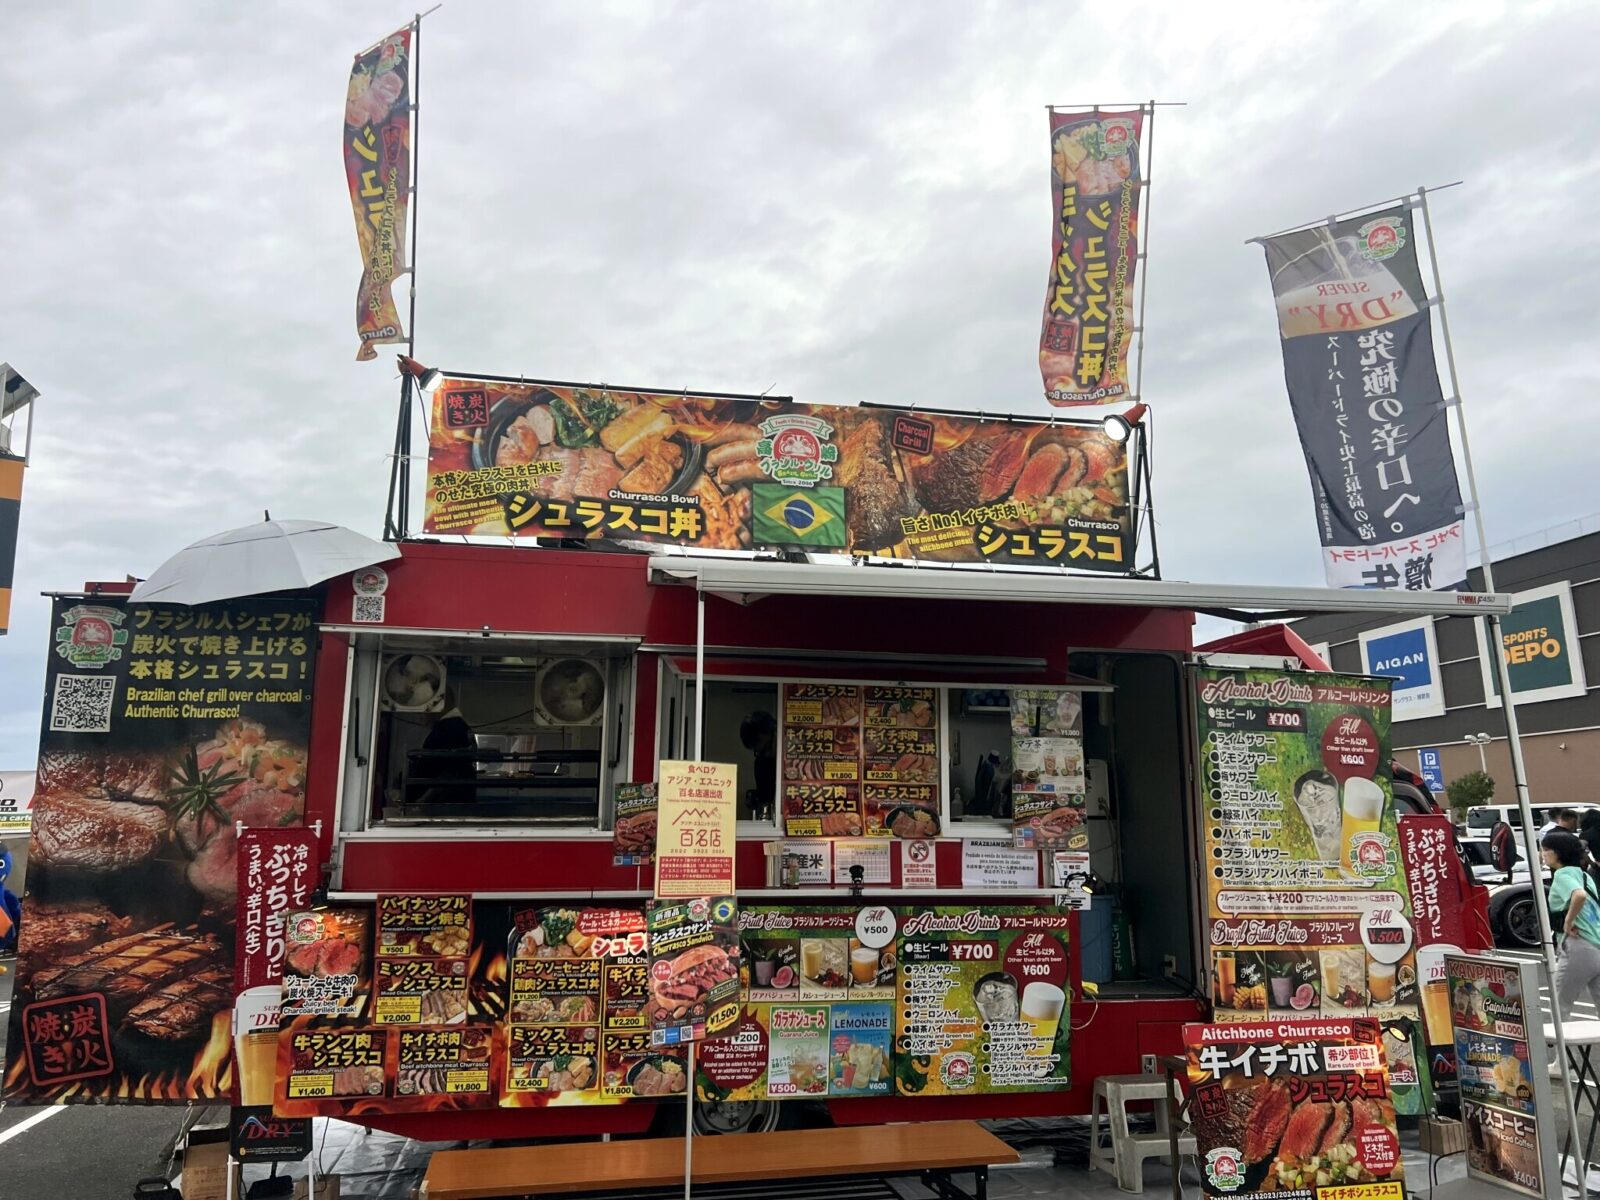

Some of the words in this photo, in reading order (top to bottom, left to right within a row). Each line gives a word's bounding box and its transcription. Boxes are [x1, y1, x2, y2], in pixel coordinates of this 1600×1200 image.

[447, 394, 466, 424] 焼き
[467, 395, 487, 424] 炭火
[898, 421, 931, 438] Charcoal
[902, 436, 922, 449] Grill
[432, 459, 563, 490] 本格シュラスコを白米に
[434, 478, 541, 505] のせた究極の肉丼！
[608, 490, 668, 503] Churrasco
[670, 493, 699, 505] Bowl
[508, 494, 702, 539] シュラスコ丼
[1068, 518, 1120, 531] Churrasco
[978, 525, 1123, 562] シュラスコ
[134, 609, 312, 631] ブラジル人シェフが
[1502, 626, 1548, 646] SPORTS
[131, 634, 308, 656] 炭火で焼き上げる
[1375, 651, 1425, 672] AIGAN
[128, 659, 308, 680] 本格シュラスコ！
[127, 686, 176, 702] Brazilian
[178, 686, 206, 702] chef
[206, 688, 229, 704] grill
[229, 690, 254, 702] over
[256, 689, 303, 703] charcoal
[806, 685, 857, 697] シュラスコ
[873, 687, 934, 700] シュラスコ丼
[1203, 676, 1268, 703] Alcohol
[1267, 677, 1313, 703] Drink
[1317, 688, 1390, 704] アルコールドリンク
[125, 703, 179, 719] Authentic
[181, 704, 241, 719] Churrasco!
[1215, 708, 1256, 720] 生ビール
[1268, 712, 1300, 726] ¥700
[1339, 717, 1361, 735] All
[786, 728, 833, 741] 牛イチボ肉
[865, 728, 919, 742] 牛イチボ肉
[1217, 733, 1275, 746] ライムサワー
[1333, 736, 1368, 746] 生ビール以外
[786, 742, 833, 754] シュラスコ
[1220, 751, 1277, 764] レモンサワー
[1340, 754, 1365, 765] ¥600
[687, 764, 717, 775] 食べログ
[667, 775, 732, 787] アジア・エスニック
[786, 785, 847, 799] 牛ランプ肉
[865, 786, 931, 799] シュラスコ丼
[1223, 791, 1279, 802] ウーロンハイ
[802, 799, 857, 813] シュラスコ
[1222, 809, 1259, 821] 緑茶ハイ
[679, 827, 722, 847] 百名店
[1223, 829, 1271, 840] ハイボール
[1223, 848, 1289, 859] ブラジルサワー
[1434, 828, 1448, 879] 冷やして
[292, 844, 310, 907] 冷やして
[1224, 866, 1324, 880] ブラジリアンハイボール
[1418, 828, 1442, 939] ぶっちぎりに
[381, 896, 468, 910] パイナップル
[264, 843, 293, 979] ぶっちぎりに
[865, 910, 886, 923] All
[1369, 909, 1392, 925] All
[381, 912, 467, 926] シナモン焼き
[738, 911, 764, 929] Fruit
[764, 911, 793, 929] Juice
[903, 911, 961, 936] Alcohol
[960, 910, 1000, 934] Drink
[1004, 917, 1068, 928] アルコールドリンク
[652, 919, 714, 945] シュラスコサンド
[863, 925, 888, 934] ¥500
[1211, 919, 1246, 948] Brazil
[1246, 919, 1275, 945] Fruit
[1275, 919, 1309, 944] Juice
[1309, 921, 1355, 933] ブラジルフルーツ
[593, 934, 648, 957] シュラ
[652, 937, 687, 957] Churrasco
[687, 934, 715, 948] Sandwich
[1023, 933, 1044, 948] All
[1321, 933, 1345, 944] ジュース
[913, 943, 949, 953] 生ビール
[952, 944, 993, 960] ¥700
[1016, 948, 1056, 956] 生ビール以外
[514, 960, 600, 975] ポークソーセージ丼
[617, 957, 635, 965] BBQ
[379, 961, 435, 976] ミックス
[912, 965, 960, 974] ライムサワー
[1022, 964, 1050, 976] ¥600
[1449, 960, 1507, 986] KANPAI!!
[286, 973, 358, 988] ジューシーな牛肉の
[402, 976, 466, 990] シュラスコ
[912, 980, 960, 989] レモンサワー
[751, 991, 797, 999] グアバジュース
[802, 991, 847, 999] カシュージュース
[912, 995, 944, 1004] 梅サワー
[303, 1000, 324, 1009] Juicy
[325, 999, 338, 1007] beef
[1481, 997, 1521, 1016] Caipirinha
[382, 1014, 411, 1023] ¥2,000
[773, 1010, 826, 1028] ガラナジュース
[912, 1009, 959, 1018] ウーロンハイ
[613, 1017, 640, 1026] ¥2,200
[834, 1017, 888, 1028] LEMONADE
[991, 1022, 1037, 1031] ガラナサワー
[512, 1027, 566, 1042] ミックス
[912, 1025, 943, 1034] 緑茶ハイ
[1201, 1025, 1274, 1041] Aitchbone
[1277, 1023, 1350, 1038] Churrasco
[30, 1013, 66, 1074] 焼き
[69, 1004, 108, 1070] 炭火
[294, 1033, 372, 1051] 牛ランプ肉
[401, 1032, 461, 1047] 牛イチボ肉
[912, 1039, 952, 1049] ハイボール
[522, 1041, 597, 1056] シュラスコ丼
[991, 1043, 1045, 1052] ブラジルサワー
[1327, 1047, 1375, 1061] 希少部位！
[1467, 1042, 1502, 1053] レモネード
[313, 1050, 381, 1067] シュラスコ
[401, 1048, 460, 1062] シュラスコ
[1199, 1040, 1319, 1079] 牛イチボ
[1464, 1051, 1501, 1063] LEMONADE
[991, 1063, 1055, 1073] ブラジルハイボール
[454, 1083, 481, 1091] ¥1,800
[515, 1078, 543, 1087] ¥2,400
[770, 1083, 797, 1093] ¥500
[869, 1082, 887, 1090] ¥600
[1289, 1072, 1387, 1103] シュラスコ
[298, 1087, 326, 1096] ¥1,400
[605, 1086, 631, 1095] ¥1,800
[1464, 1101, 1535, 1137] アイスコーヒー
[1364, 1142, 1391, 1153] ビネガー
[1513, 1137, 1535, 1150] Coffee
[1363, 1151, 1395, 1162] ソース付き
[1513, 1170, 1538, 1188] ¥400
[1320, 1184, 1398, 1200] 牛イチボシュラスコ
